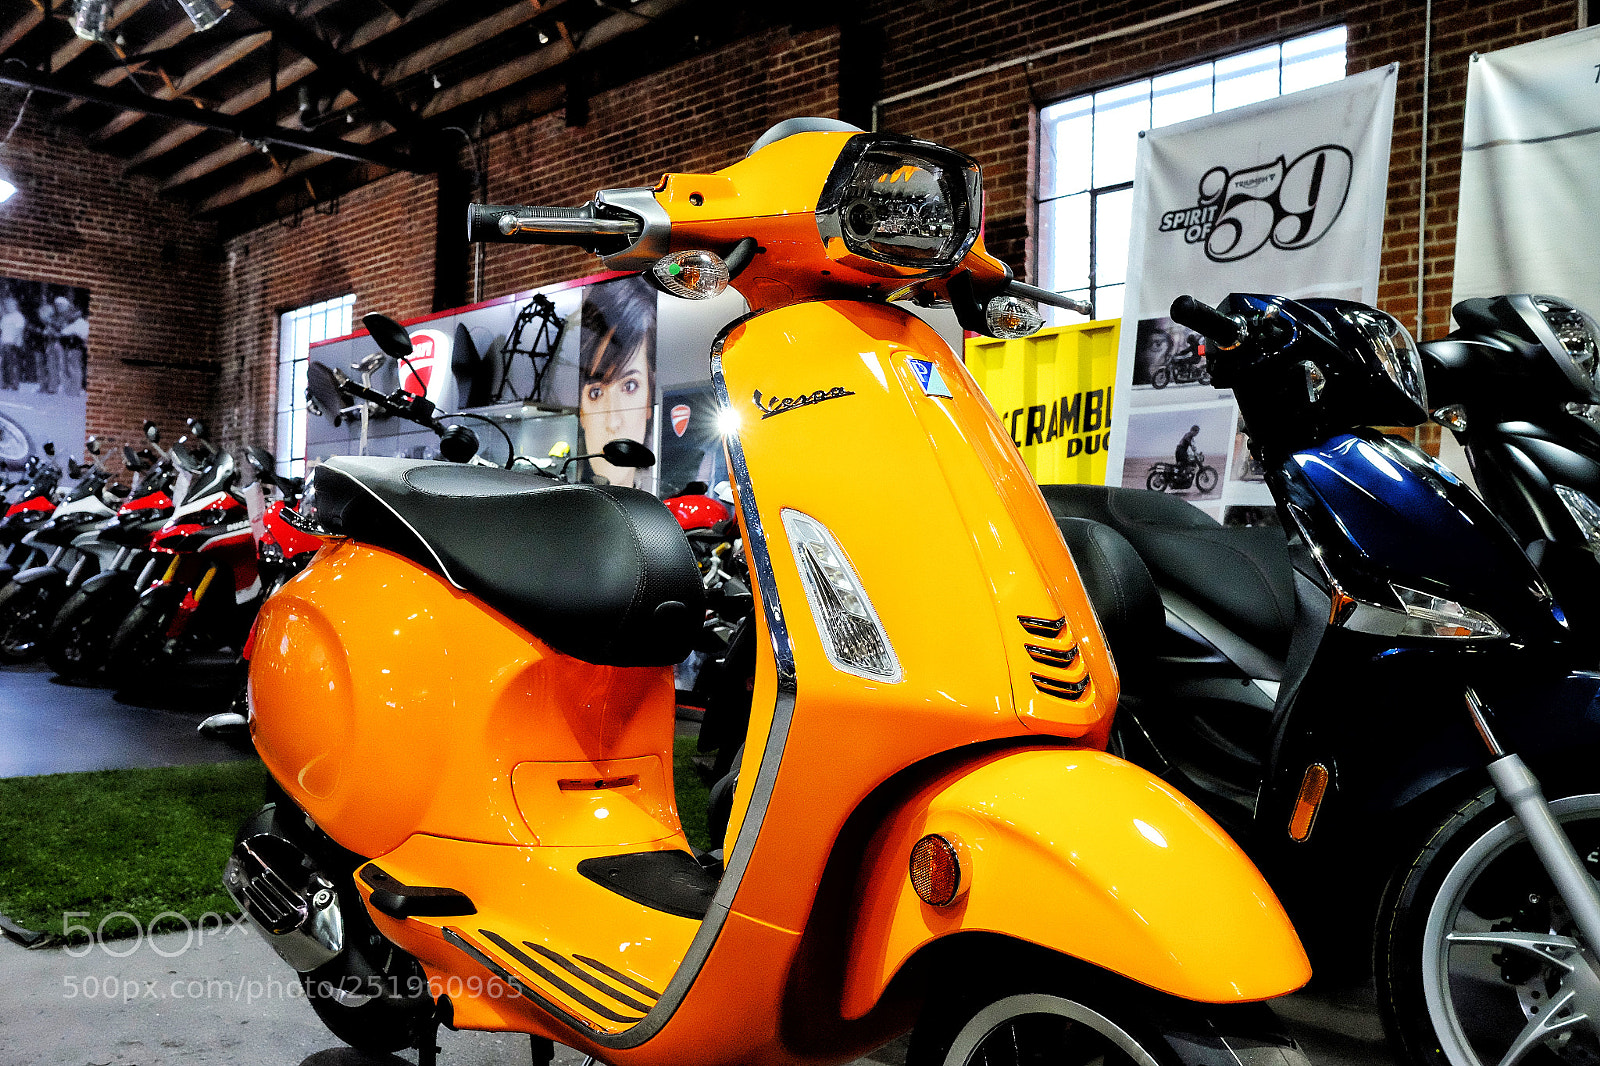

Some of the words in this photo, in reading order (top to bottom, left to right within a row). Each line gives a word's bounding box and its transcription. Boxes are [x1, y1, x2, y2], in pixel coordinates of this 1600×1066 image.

[1160, 204, 1218, 231] SPIRIT
[1185, 223, 1213, 243] OF
[752, 386, 856, 420] Vespa
[1002, 386, 1112, 448] CRAMBL
